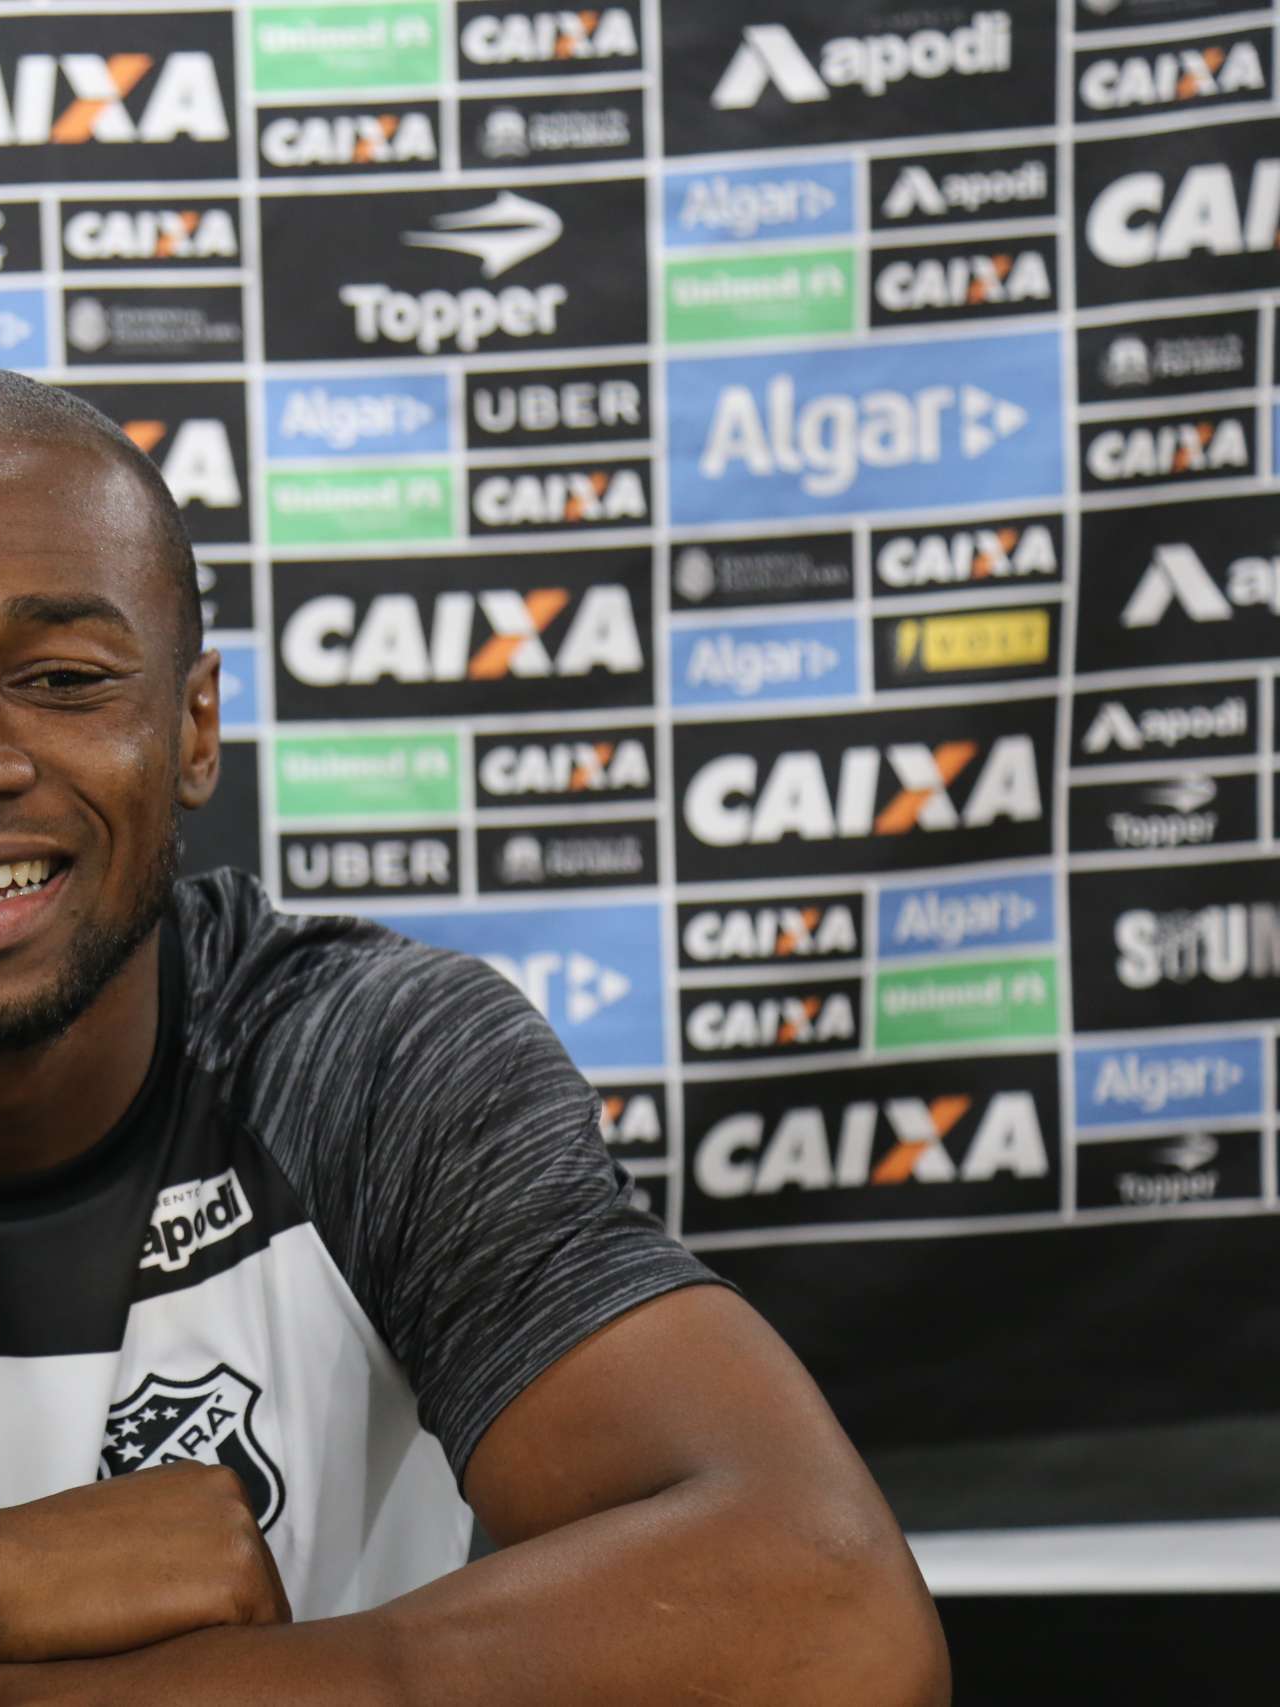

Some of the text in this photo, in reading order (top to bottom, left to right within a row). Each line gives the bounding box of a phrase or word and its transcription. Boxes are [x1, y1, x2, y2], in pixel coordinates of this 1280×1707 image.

[461, 9, 637, 63] CAIXA
[1079, 40, 1266, 110] CAIXA
[262, 113, 435, 166] CAIXA
[64, 210, 236, 259] CAIXA
[682, 178, 798, 235] Algar
[875, 250, 1051, 311] CAIXA
[340, 285, 567, 352] Topper
[282, 388, 395, 446] Algar
[475, 381, 639, 432] UBER
[700, 375, 953, 497] Algar
[1087, 418, 1250, 480] CAIXA
[474, 471, 645, 525] CAIXA
[877, 525, 1057, 586] CAIXA
[282, 586, 642, 685] CAIXA
[688, 635, 803, 694] Algar
[480, 741, 649, 794] CAIXA
[684, 737, 1040, 846] CAIXA
[1110, 810, 1215, 847] Topper
[288, 840, 449, 888] UBER
[683, 905, 857, 960] CAIXA
[895, 892, 1005, 945] Algar
[687, 993, 855, 1050] CAIXA
[1092, 1054, 1206, 1113] Algar
[696, 1092, 1047, 1196] CAIXA
[1118, 1172, 1218, 1205] Topper
[140, 1178, 242, 1262] apodi
